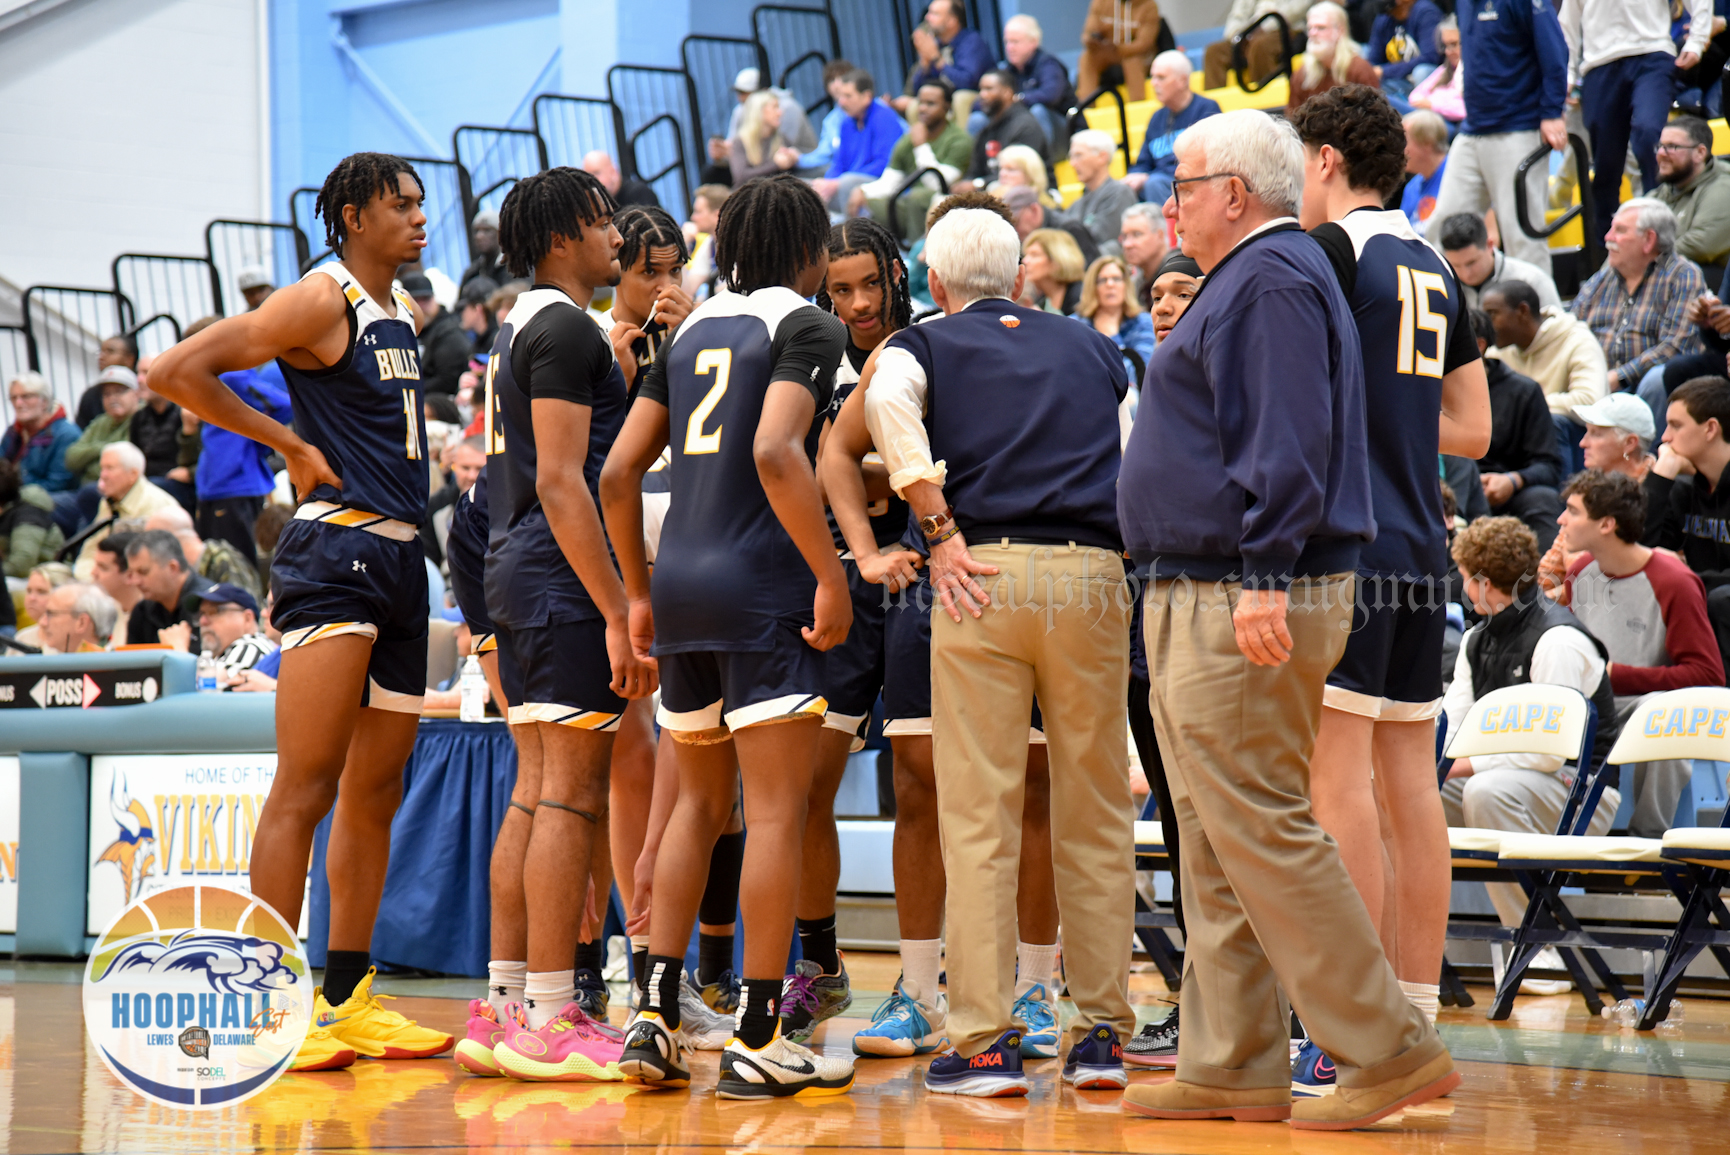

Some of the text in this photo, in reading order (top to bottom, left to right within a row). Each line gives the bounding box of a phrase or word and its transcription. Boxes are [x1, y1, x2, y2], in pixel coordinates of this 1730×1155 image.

[1396, 264, 1448, 380] 15
[683, 347, 732, 455] 2
[47, 678, 83, 705] POSS
[115, 681, 142, 699] BONUS
[1480, 703, 1565, 734] CAPE
[1643, 706, 1730, 738] CAPE
[185, 767, 274, 784] HOME OF TH
[154, 794, 268, 876] VIKIN
[968, 1052, 1003, 1068] HOKA
